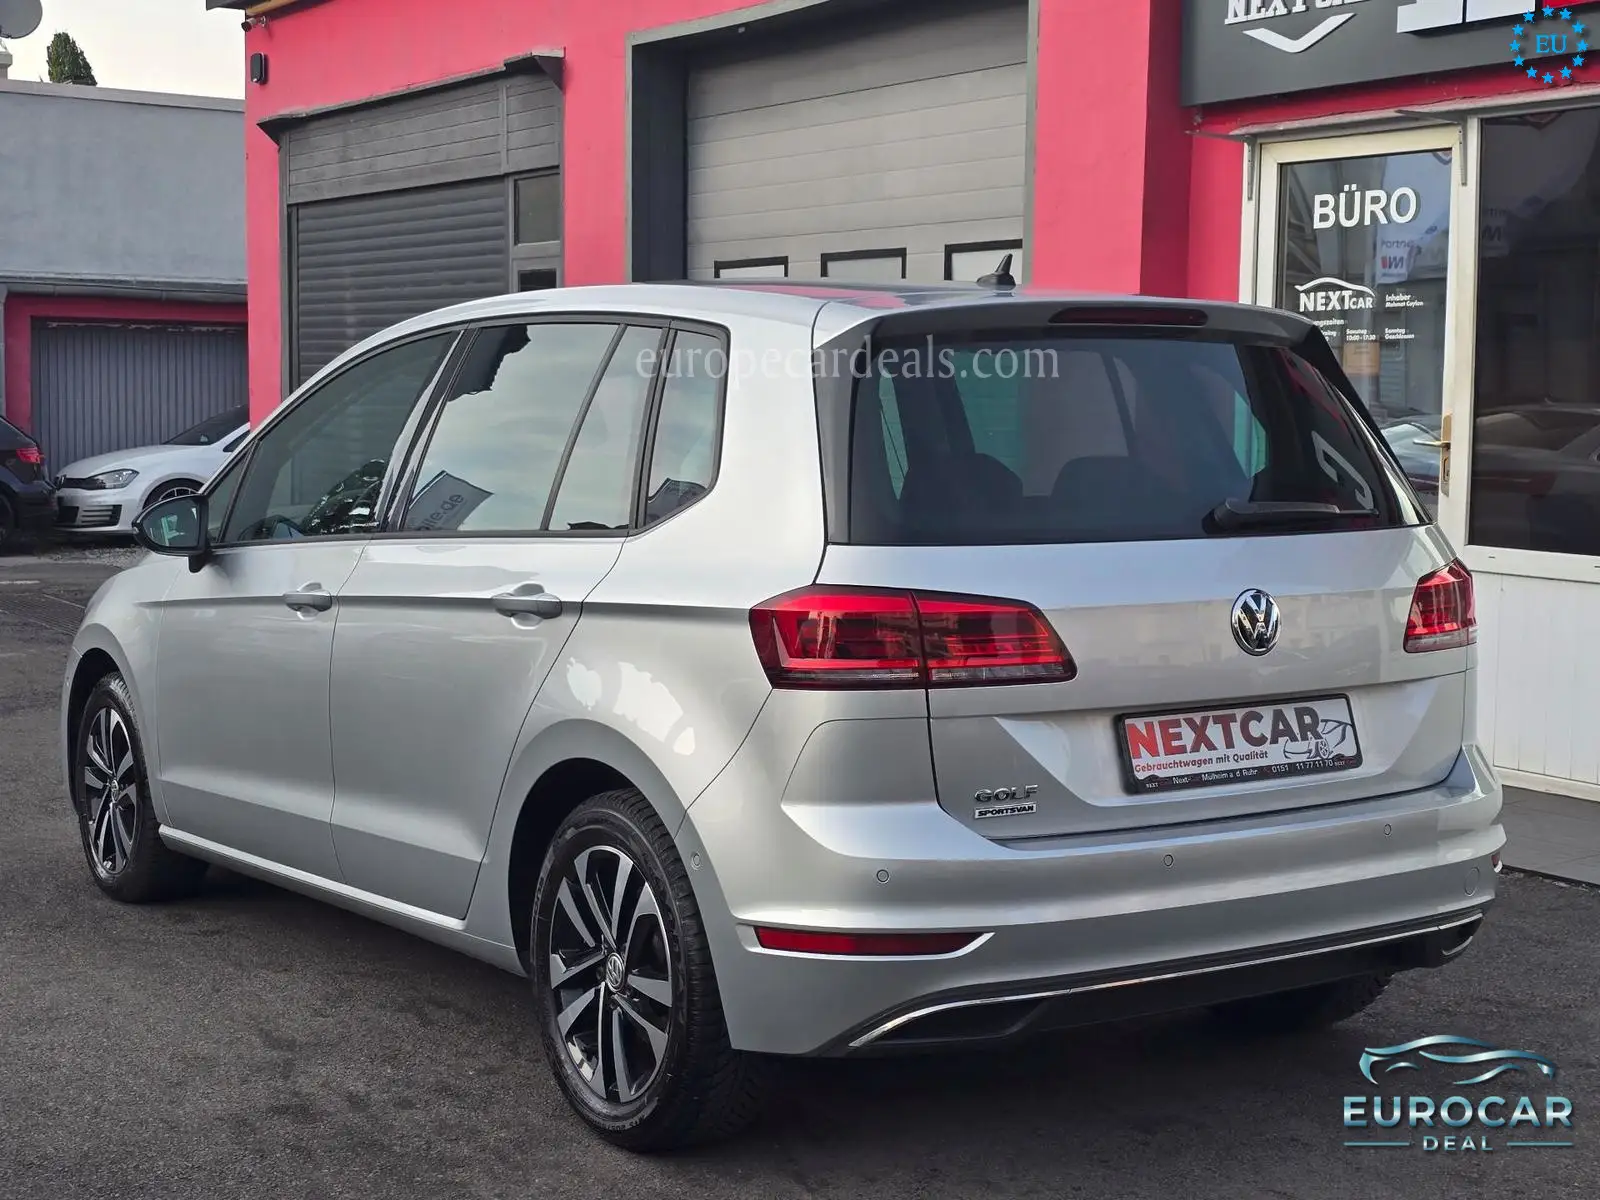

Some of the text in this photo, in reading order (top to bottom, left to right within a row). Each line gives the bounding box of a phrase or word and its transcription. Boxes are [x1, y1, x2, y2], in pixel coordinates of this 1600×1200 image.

[1313, 183, 1417, 229] BÜRO
[1126, 706, 1324, 759] NEXTCAR
[1134, 751, 1268, 773] Gebrauchtwagen mit Qualität
[1271, 764, 1289, 773] 0151
[975, 784, 1038, 802] GOLF
[977, 805, 1034, 817] SPORTSVAN
